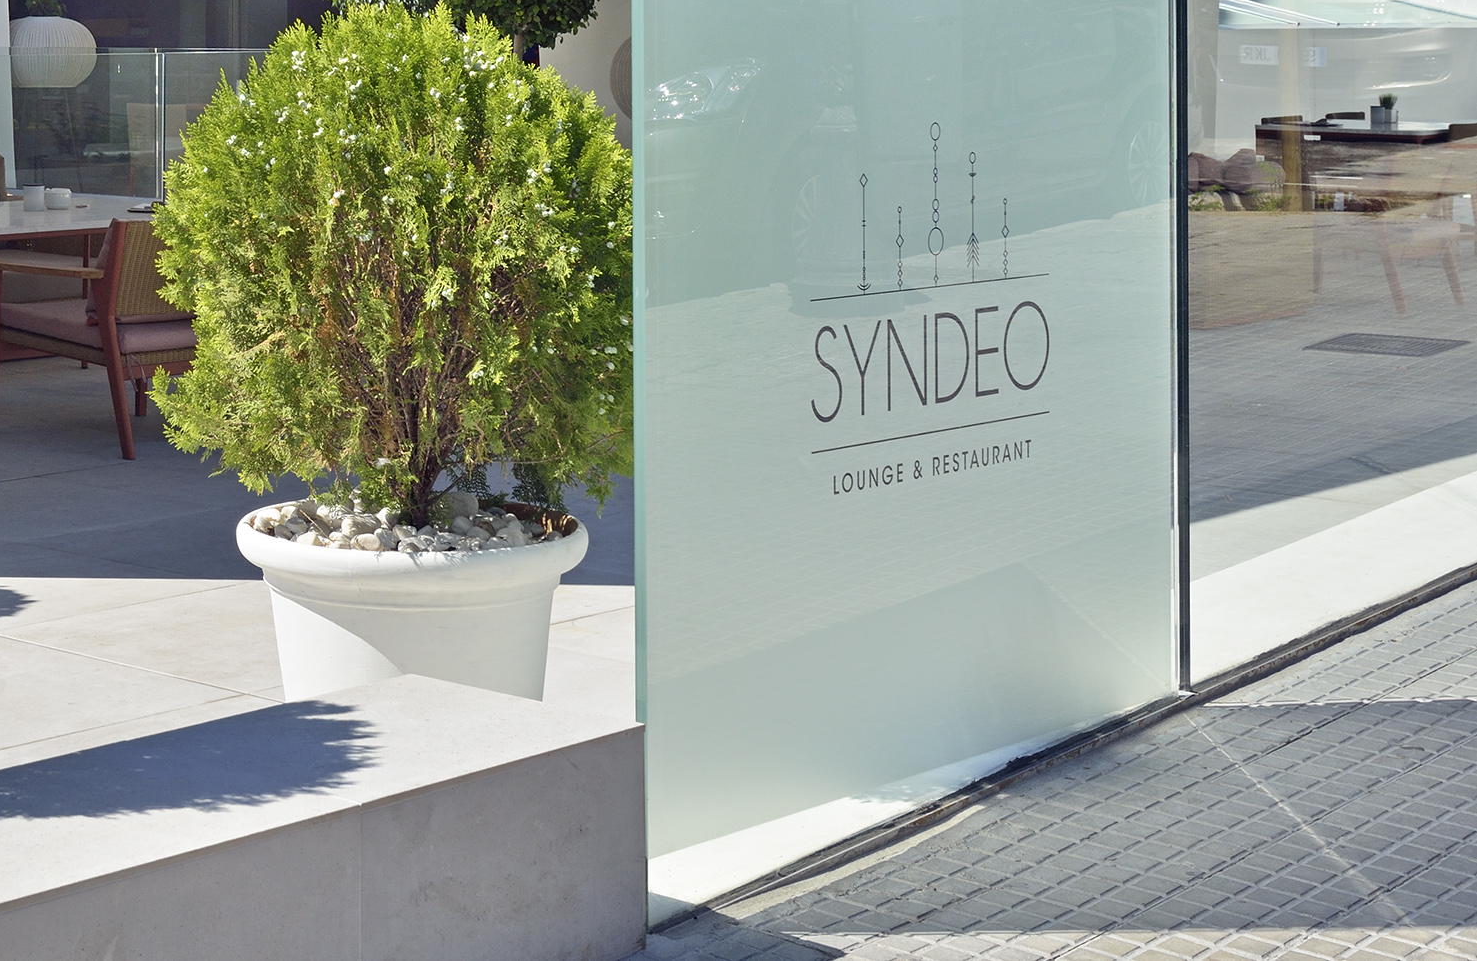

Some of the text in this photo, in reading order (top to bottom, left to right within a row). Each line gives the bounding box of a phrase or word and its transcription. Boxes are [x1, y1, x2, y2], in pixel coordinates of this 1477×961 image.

[810, 300, 1050, 423] SYNDEO
[833, 439, 1033, 495] LOUNGE & RESTAURANT
